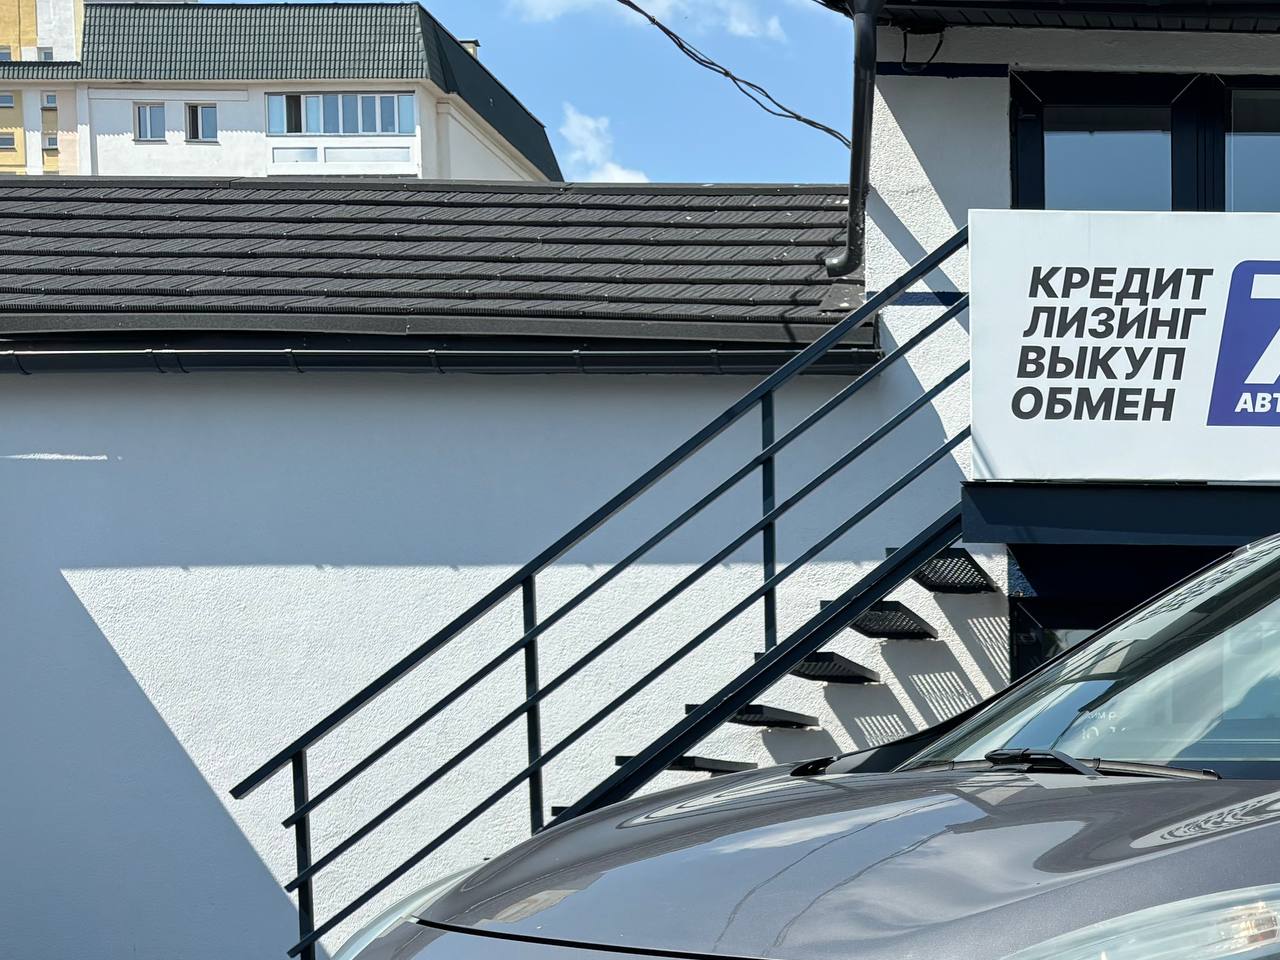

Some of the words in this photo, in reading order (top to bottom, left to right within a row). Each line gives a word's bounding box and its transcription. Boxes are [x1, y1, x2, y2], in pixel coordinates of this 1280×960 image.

[1028, 266, 1213, 305] КРЕДИТ
[1022, 306, 1206, 340] ЛИЗИНГ
[1016, 345, 1186, 381] ВЫКУП
[1010, 386, 1176, 422] ОБМЕН
